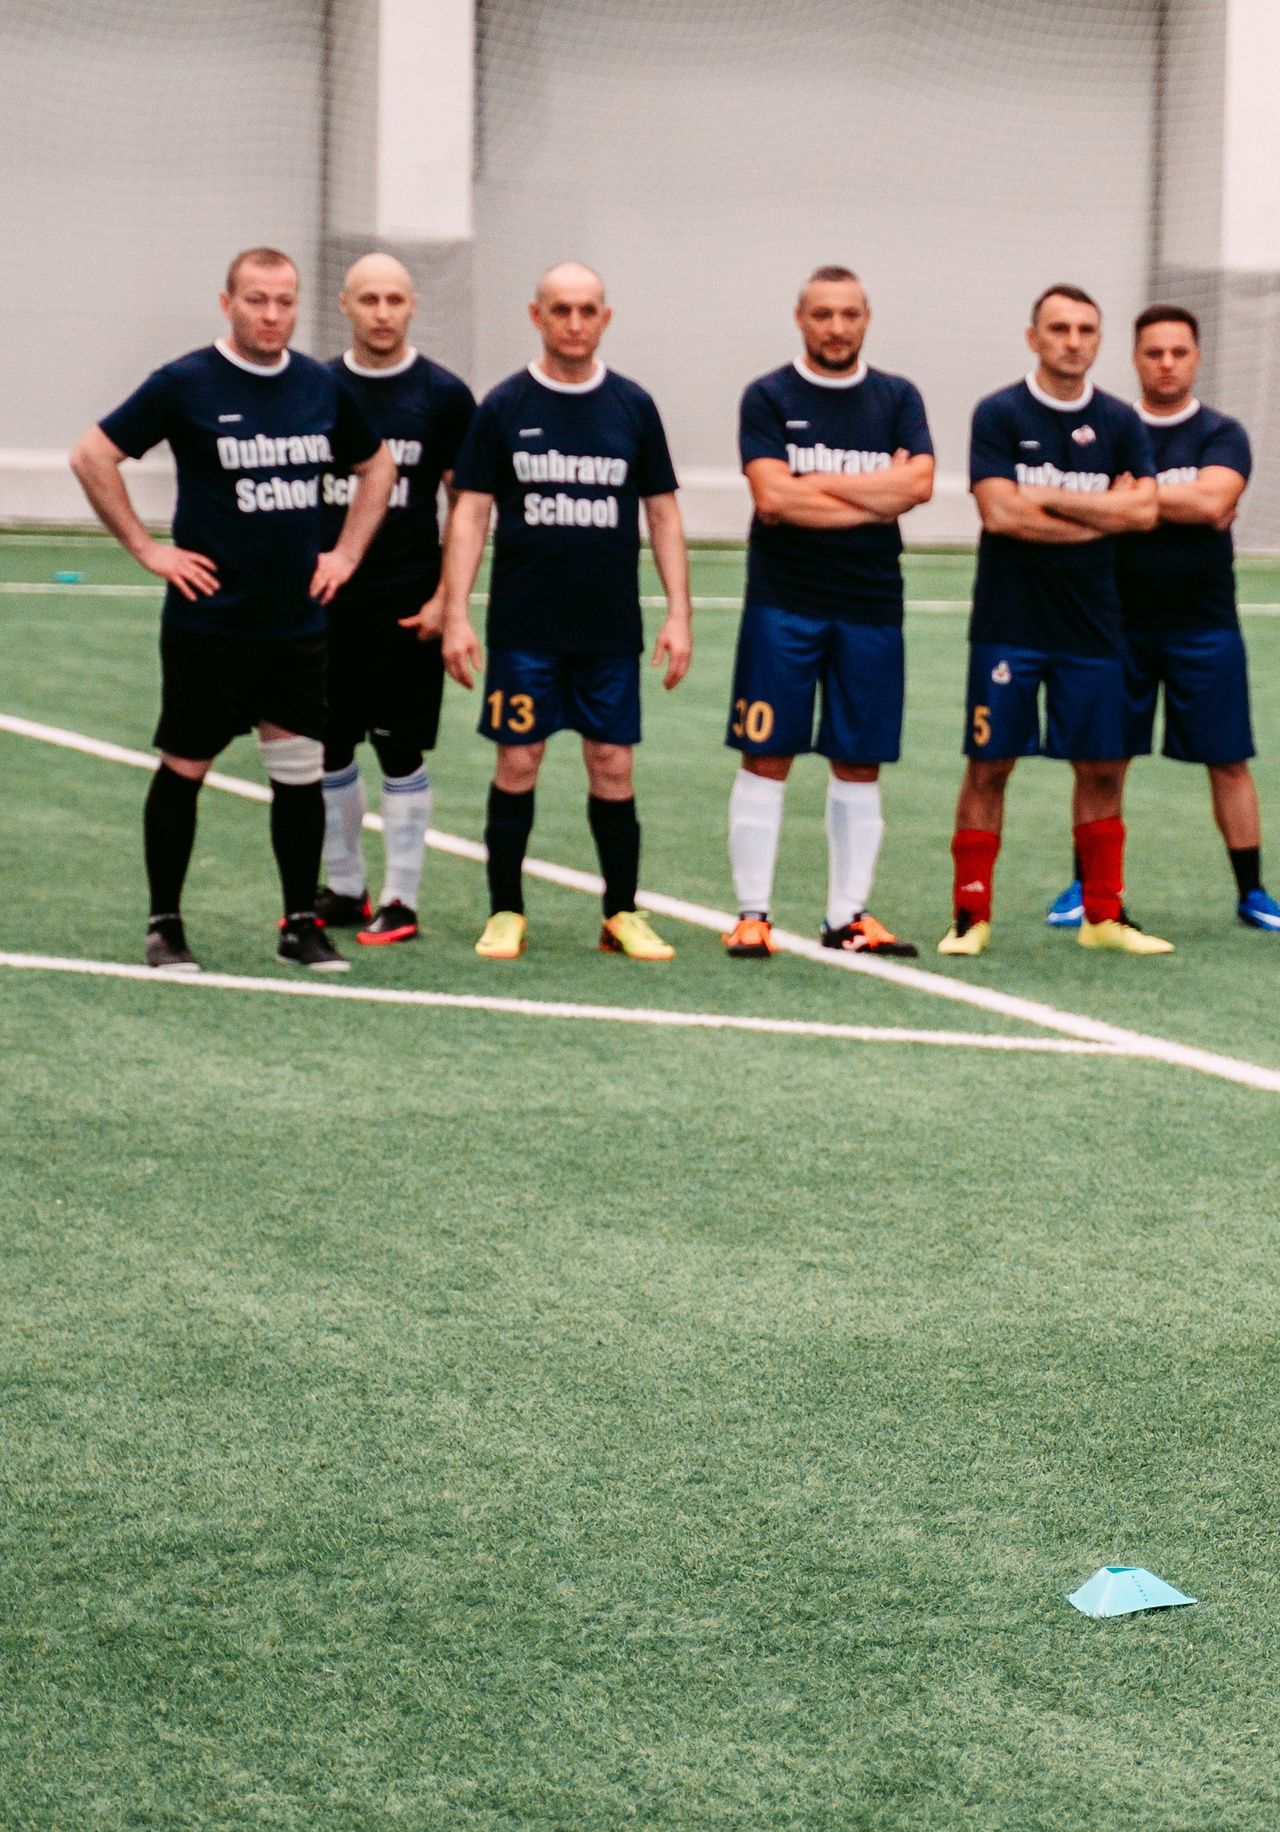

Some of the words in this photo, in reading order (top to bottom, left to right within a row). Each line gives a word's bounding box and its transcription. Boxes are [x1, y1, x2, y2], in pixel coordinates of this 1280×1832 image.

[512, 449, 629, 487] Dubrava
[523, 492, 619, 529] School
[487, 688, 536, 734] 13
